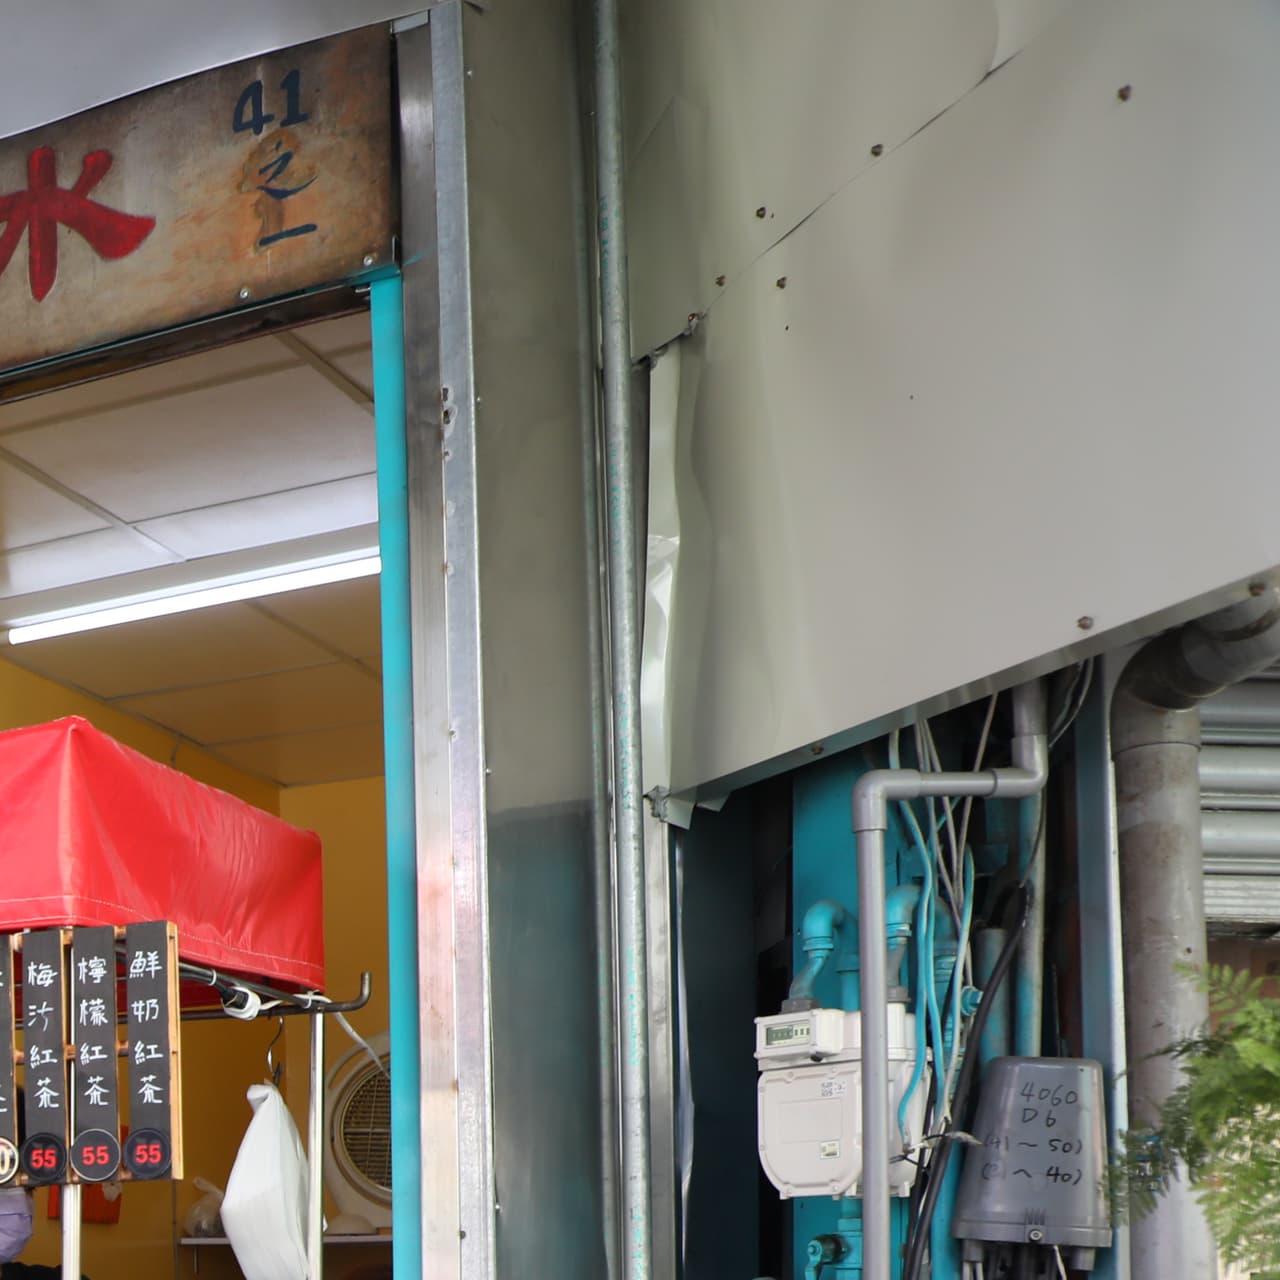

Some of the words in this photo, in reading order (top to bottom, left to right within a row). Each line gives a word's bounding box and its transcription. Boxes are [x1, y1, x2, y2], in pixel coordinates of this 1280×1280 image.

[26, 960, 60, 1109] 梅汁紅茶
[77, 955, 110, 1106] 檸檬紅茶
[129, 950, 164, 1105] 鮮奶紅茶
[1020, 1081, 1079, 1107] 4060
[30, 1148, 58, 1170] 55
[81, 1146, 110, 1166] 55
[134, 1143, 163, 1165] 55
